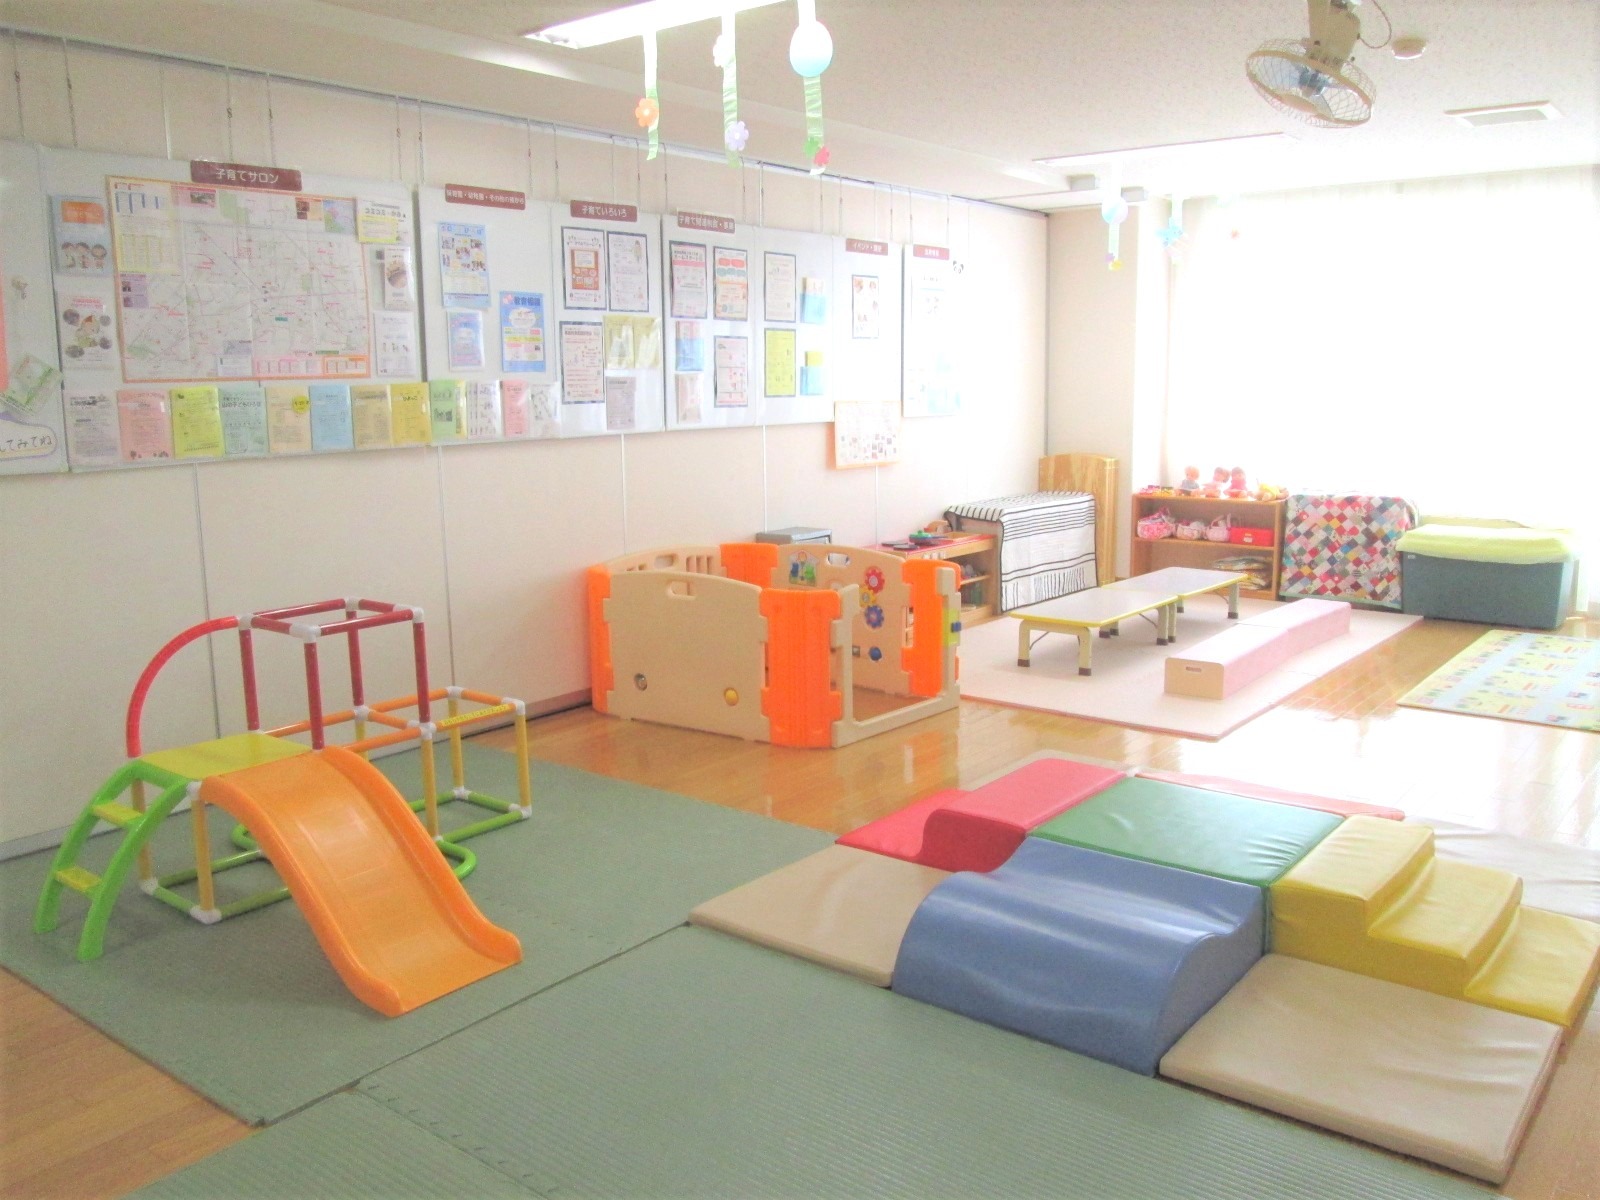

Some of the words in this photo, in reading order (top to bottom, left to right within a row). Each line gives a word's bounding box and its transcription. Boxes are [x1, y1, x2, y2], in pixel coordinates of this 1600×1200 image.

[215, 168, 279, 184] 子育てサロン
[581, 205, 627, 218] 子育ていろいろ
